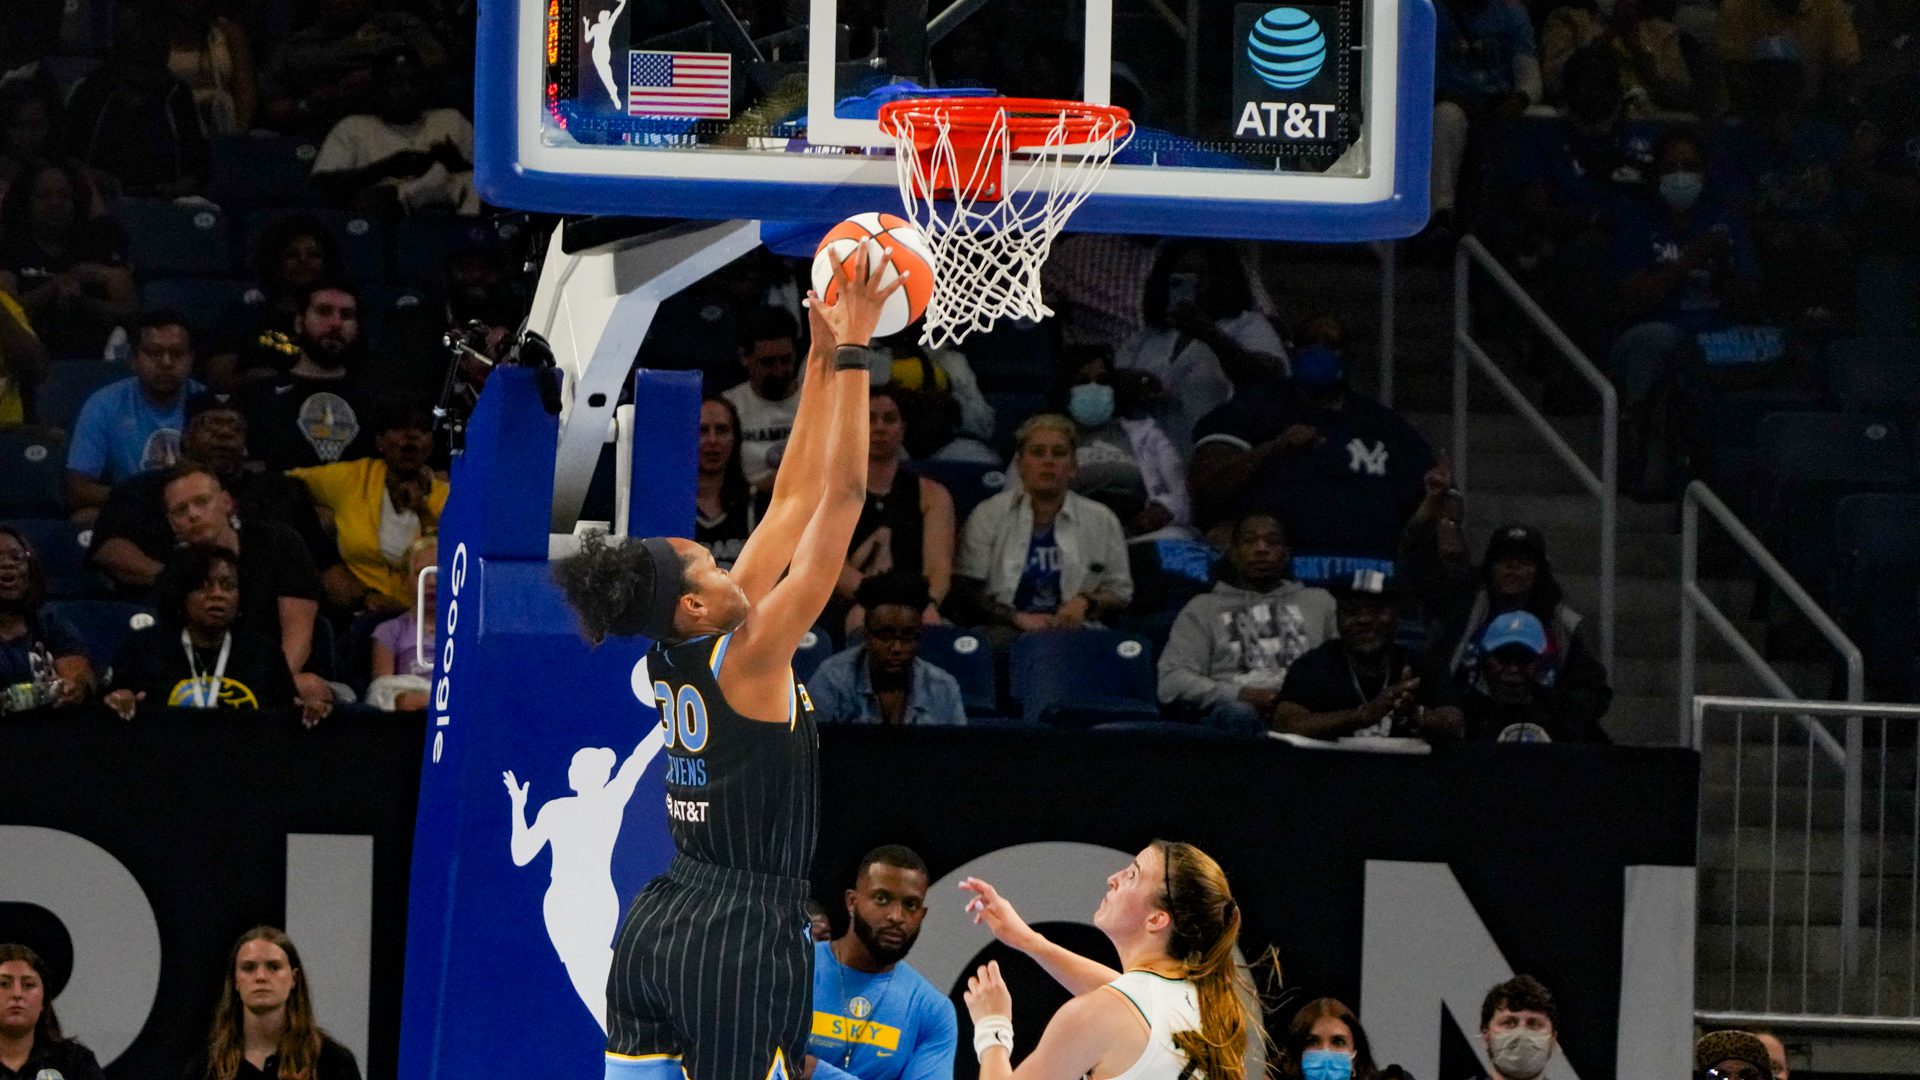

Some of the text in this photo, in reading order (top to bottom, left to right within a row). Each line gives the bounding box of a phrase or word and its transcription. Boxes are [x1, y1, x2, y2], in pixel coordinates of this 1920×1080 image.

[1235, 101, 1335, 138] AT&T
[433, 542, 467, 763] Google
[654, 680, 709, 752] 30
[666, 754, 707, 786] EVENS
[673, 799, 709, 822] AT&T
[831, 1019, 882, 1041] SKY
